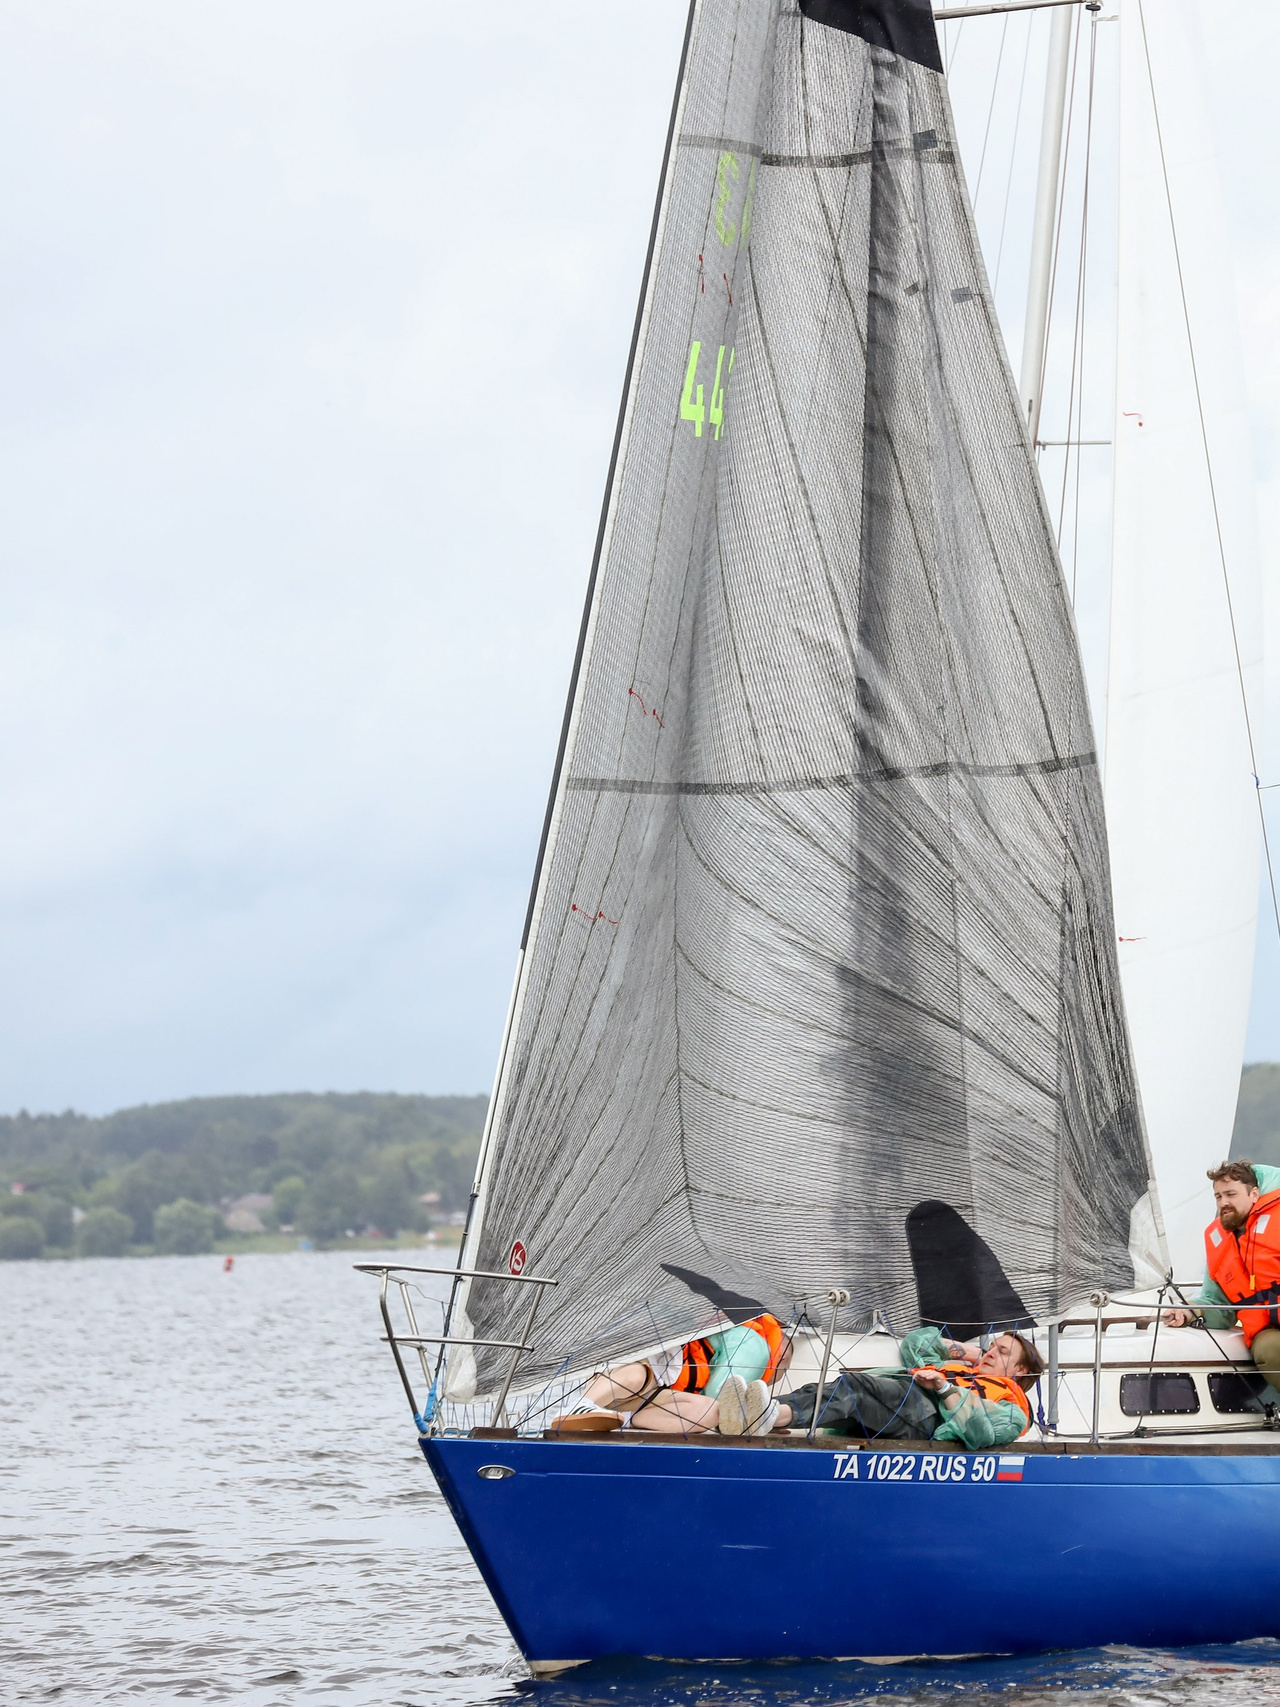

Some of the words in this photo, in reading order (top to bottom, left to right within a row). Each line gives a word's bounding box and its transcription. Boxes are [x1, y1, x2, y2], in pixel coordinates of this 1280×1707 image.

[833, 1454, 859, 1479] TA
[866, 1454, 916, 1480] 1022
[918, 1456, 967, 1482] RUS
[970, 1456, 996, 1482] 50
